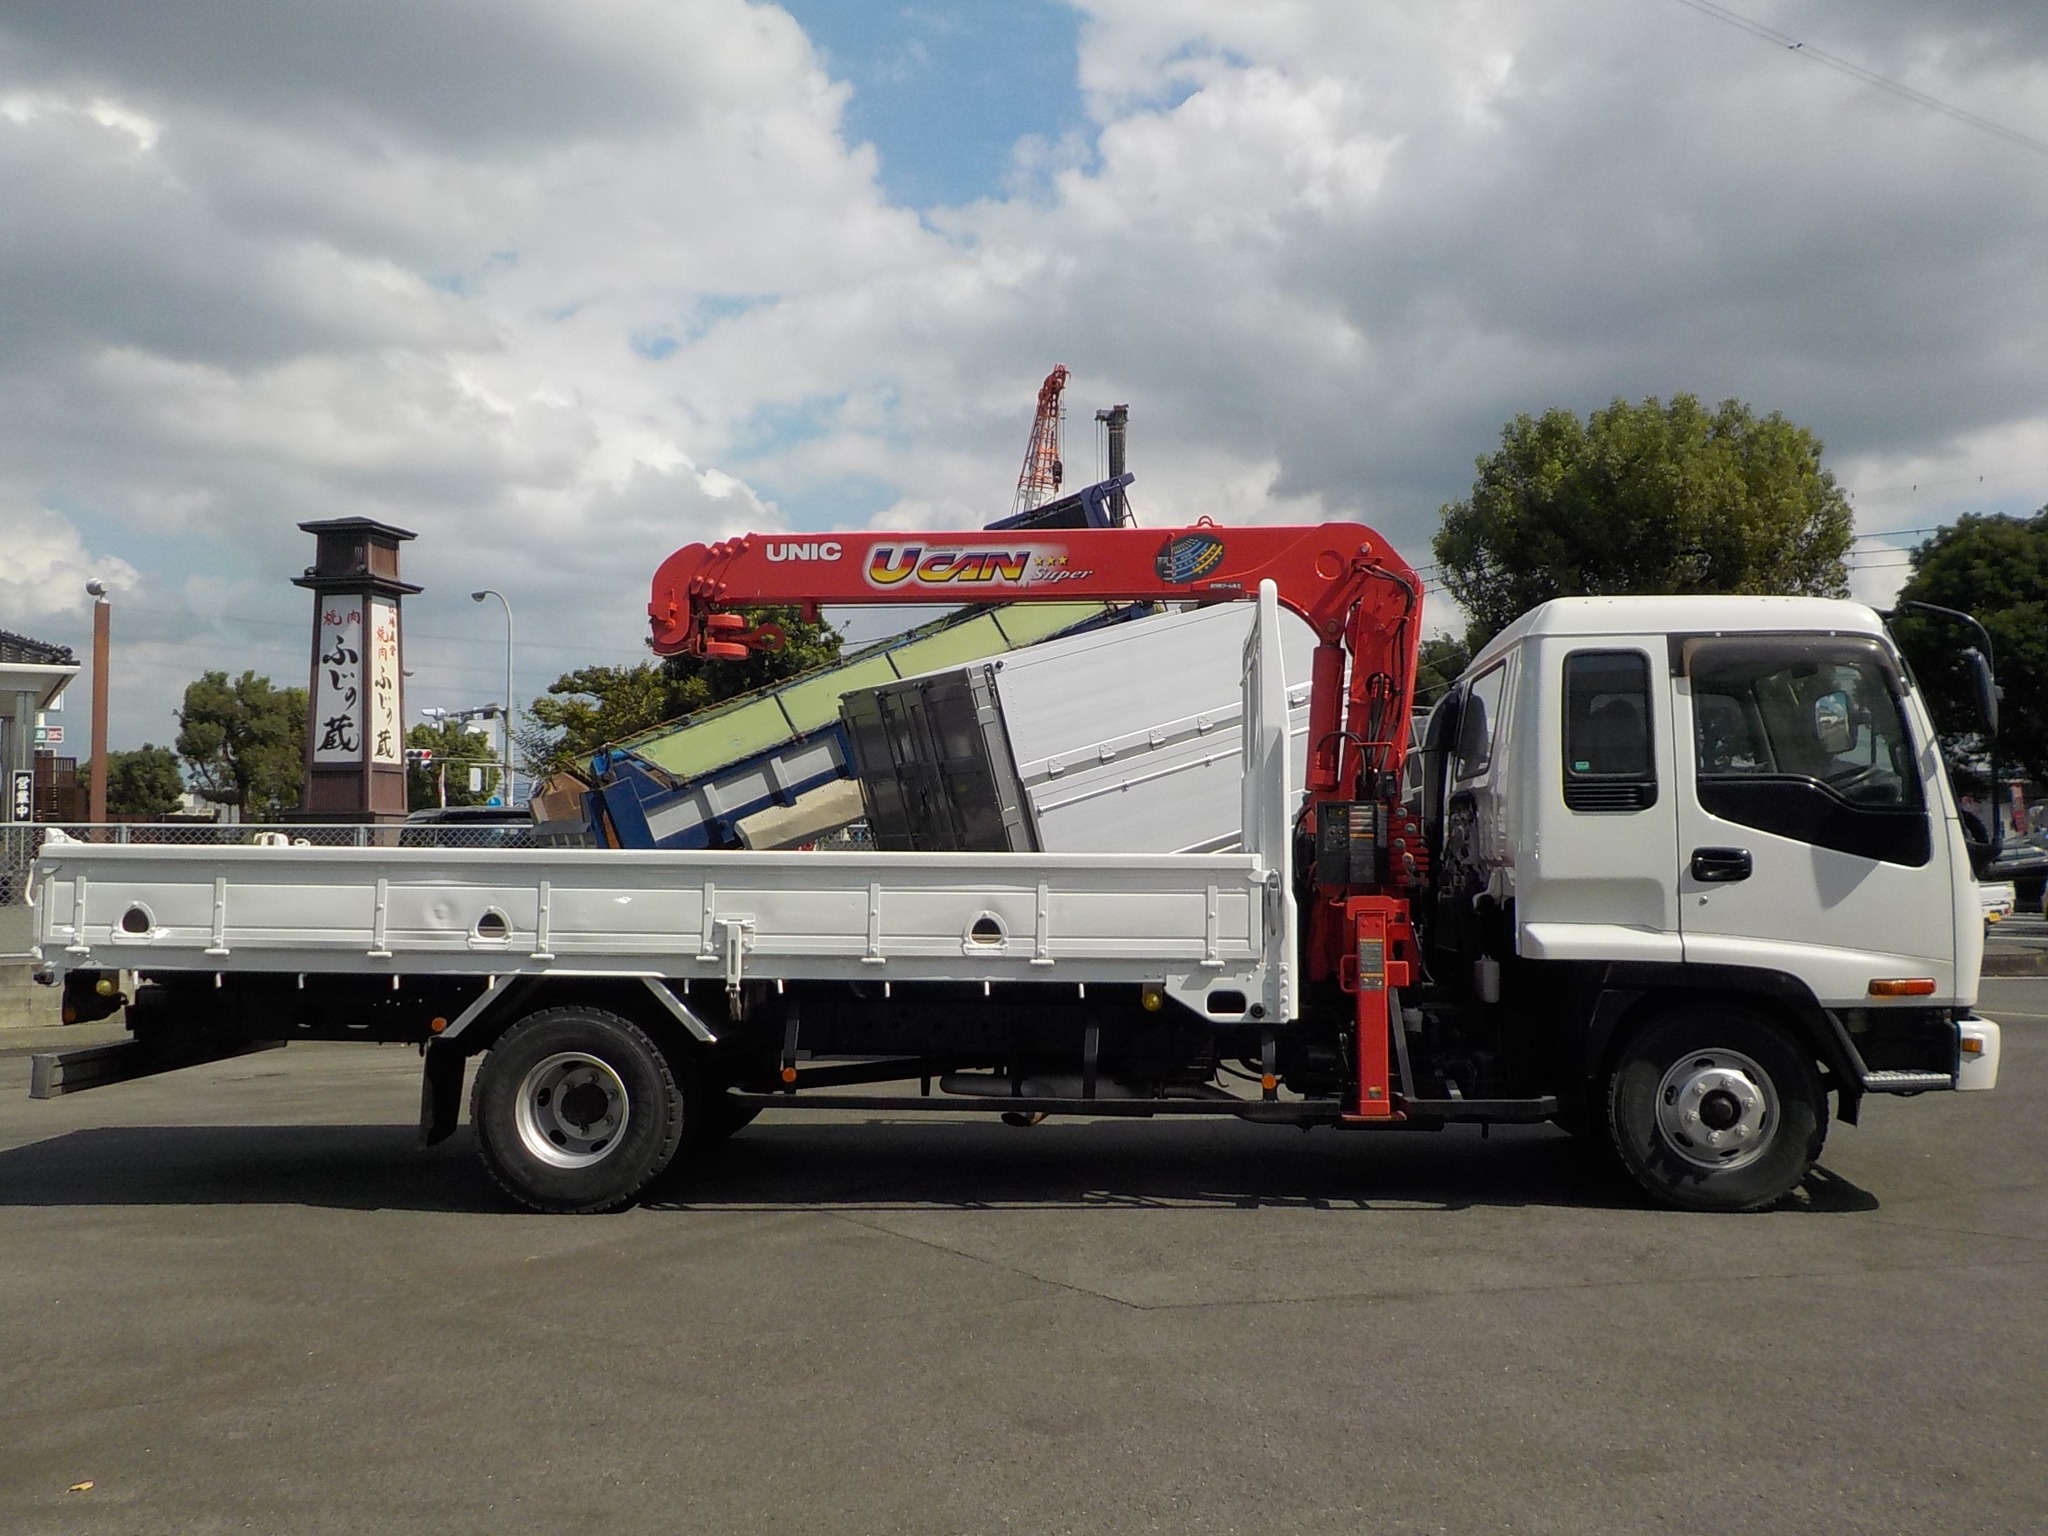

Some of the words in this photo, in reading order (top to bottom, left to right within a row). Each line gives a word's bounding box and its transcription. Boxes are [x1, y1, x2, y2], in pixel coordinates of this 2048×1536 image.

[766, 542, 842, 562] UNIC
[869, 547, 1029, 584] UCAN
[1030, 568, 1095, 584] Super
[323, 610, 361, 626] 焼肉
[377, 624, 389, 661] 焼肉
[16, 776, 30, 818] 営業中
